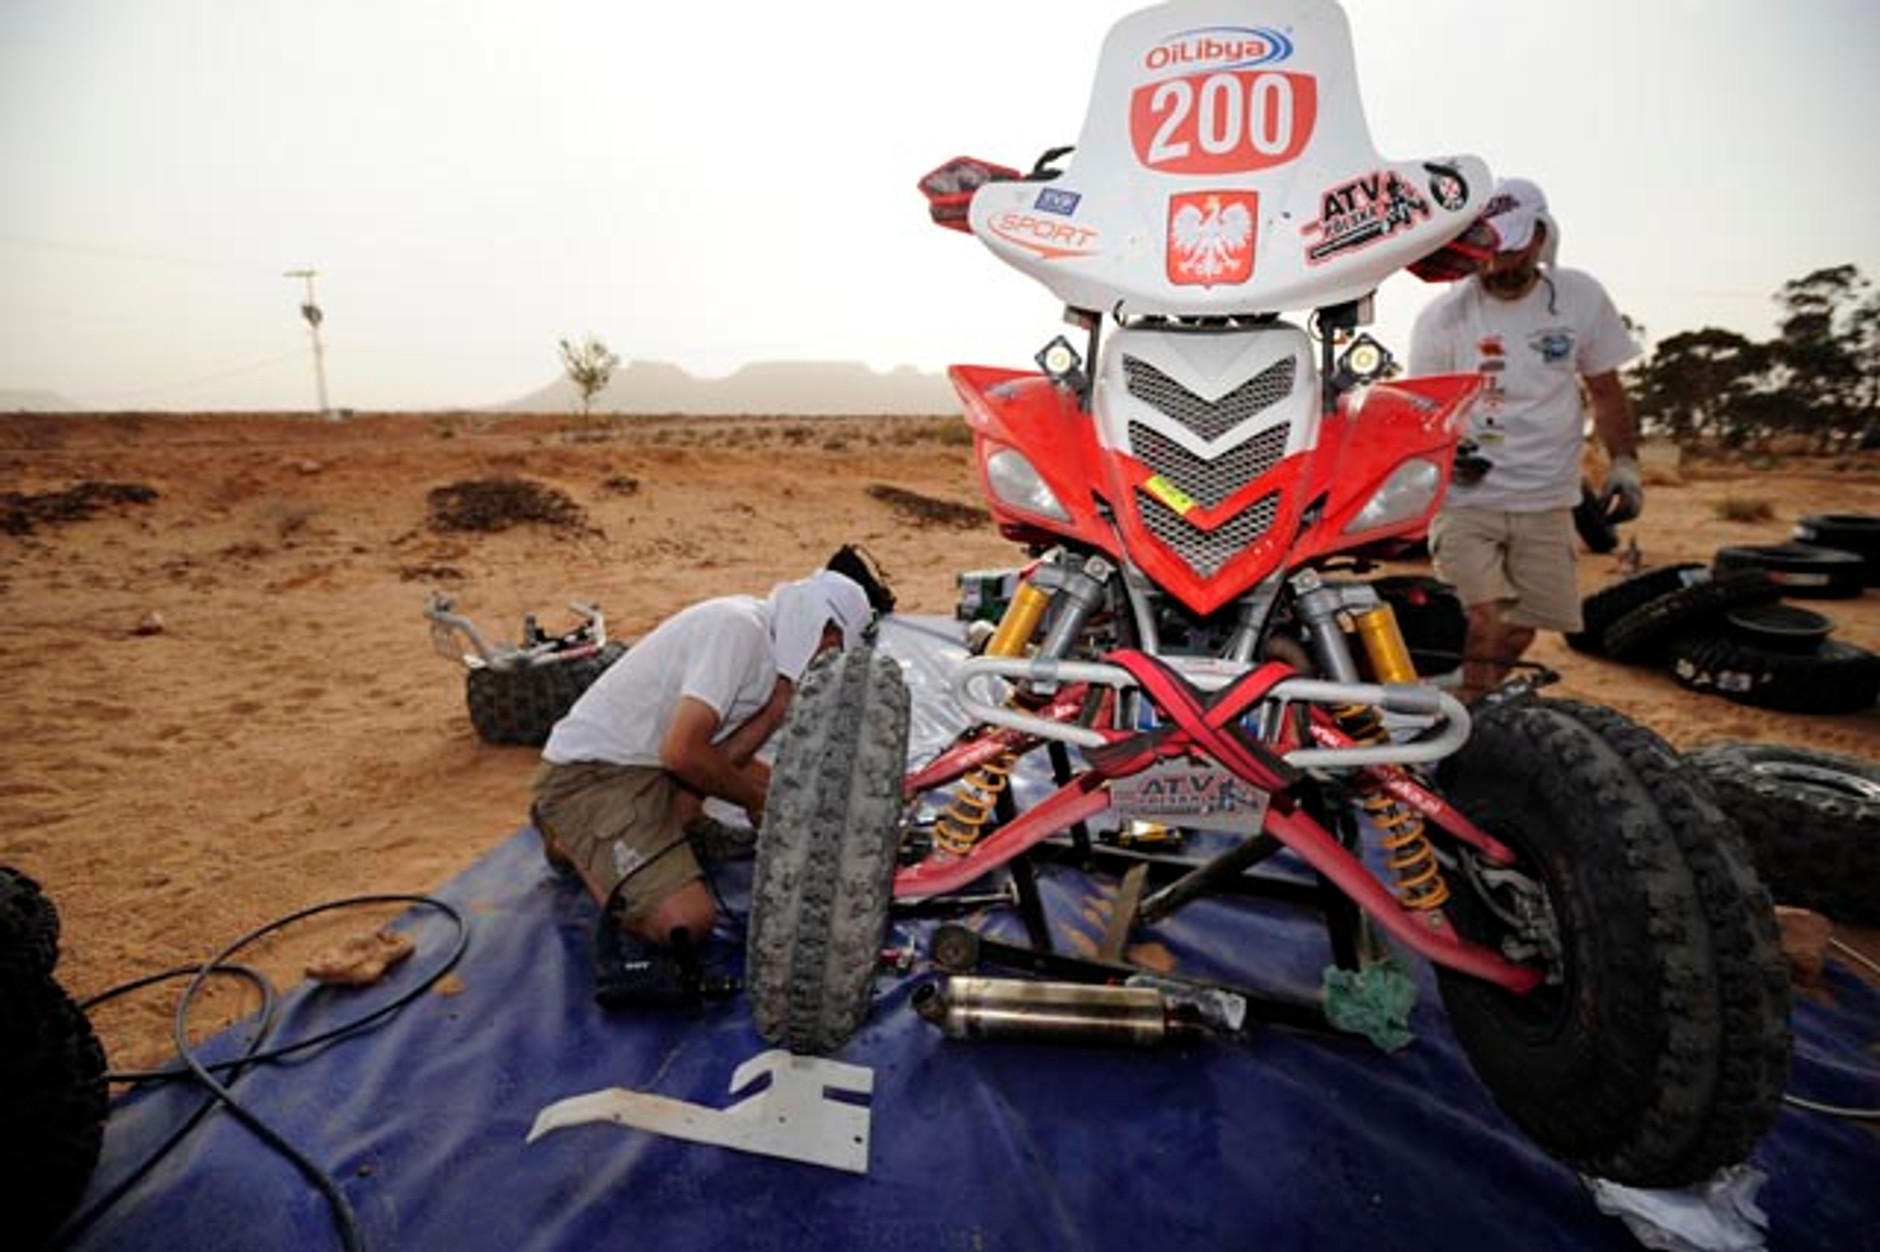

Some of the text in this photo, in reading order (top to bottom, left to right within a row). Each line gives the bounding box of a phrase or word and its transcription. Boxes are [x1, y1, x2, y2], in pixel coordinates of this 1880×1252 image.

[1146, 38, 1266, 69] OiLibya
[1148, 73, 1293, 163] 200
[1324, 173, 1379, 221] ATV
[1000, 214, 1098, 247] SPORT
[1143, 776, 1214, 795] ATV
